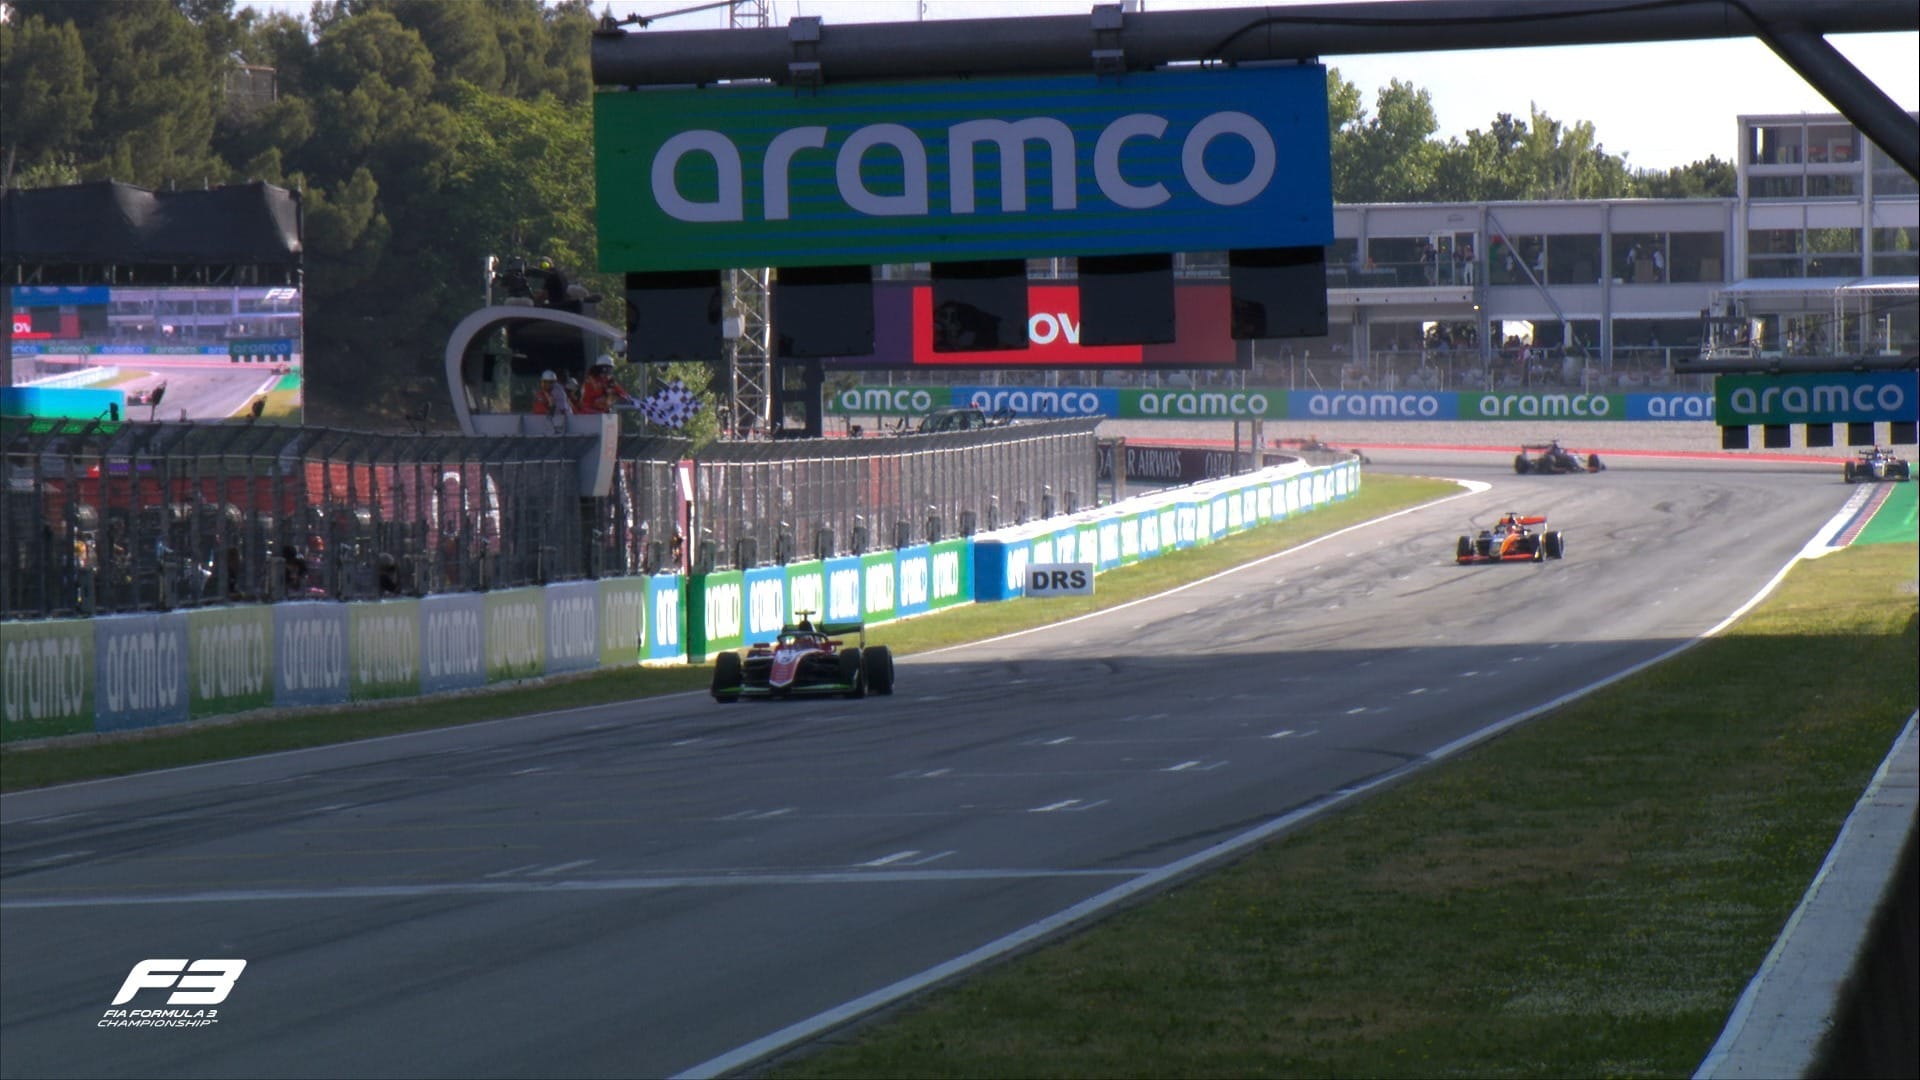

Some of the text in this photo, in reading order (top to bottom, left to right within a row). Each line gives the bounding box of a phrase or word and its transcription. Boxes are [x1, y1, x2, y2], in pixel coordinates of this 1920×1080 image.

[650, 110, 1277, 223] aramco
[264, 288, 298, 300] F3
[971, 390, 1099, 414] aramco
[1139, 393, 1269, 415] aramco
[1309, 393, 1439, 416] aramco
[1478, 394, 1610, 417] aramco
[1730, 384, 1905, 415] aramco
[1138, 449, 1182, 478] AIRWAYS
[1031, 569, 1087, 591] DRS
[282, 619, 342, 691] aramco
[358, 615, 412, 685] aramco
[428, 609, 480, 678] aramco
[107, 632, 178, 713] aramco
[200, 622, 264, 700] aramco
[5, 638, 84, 722] aramco
